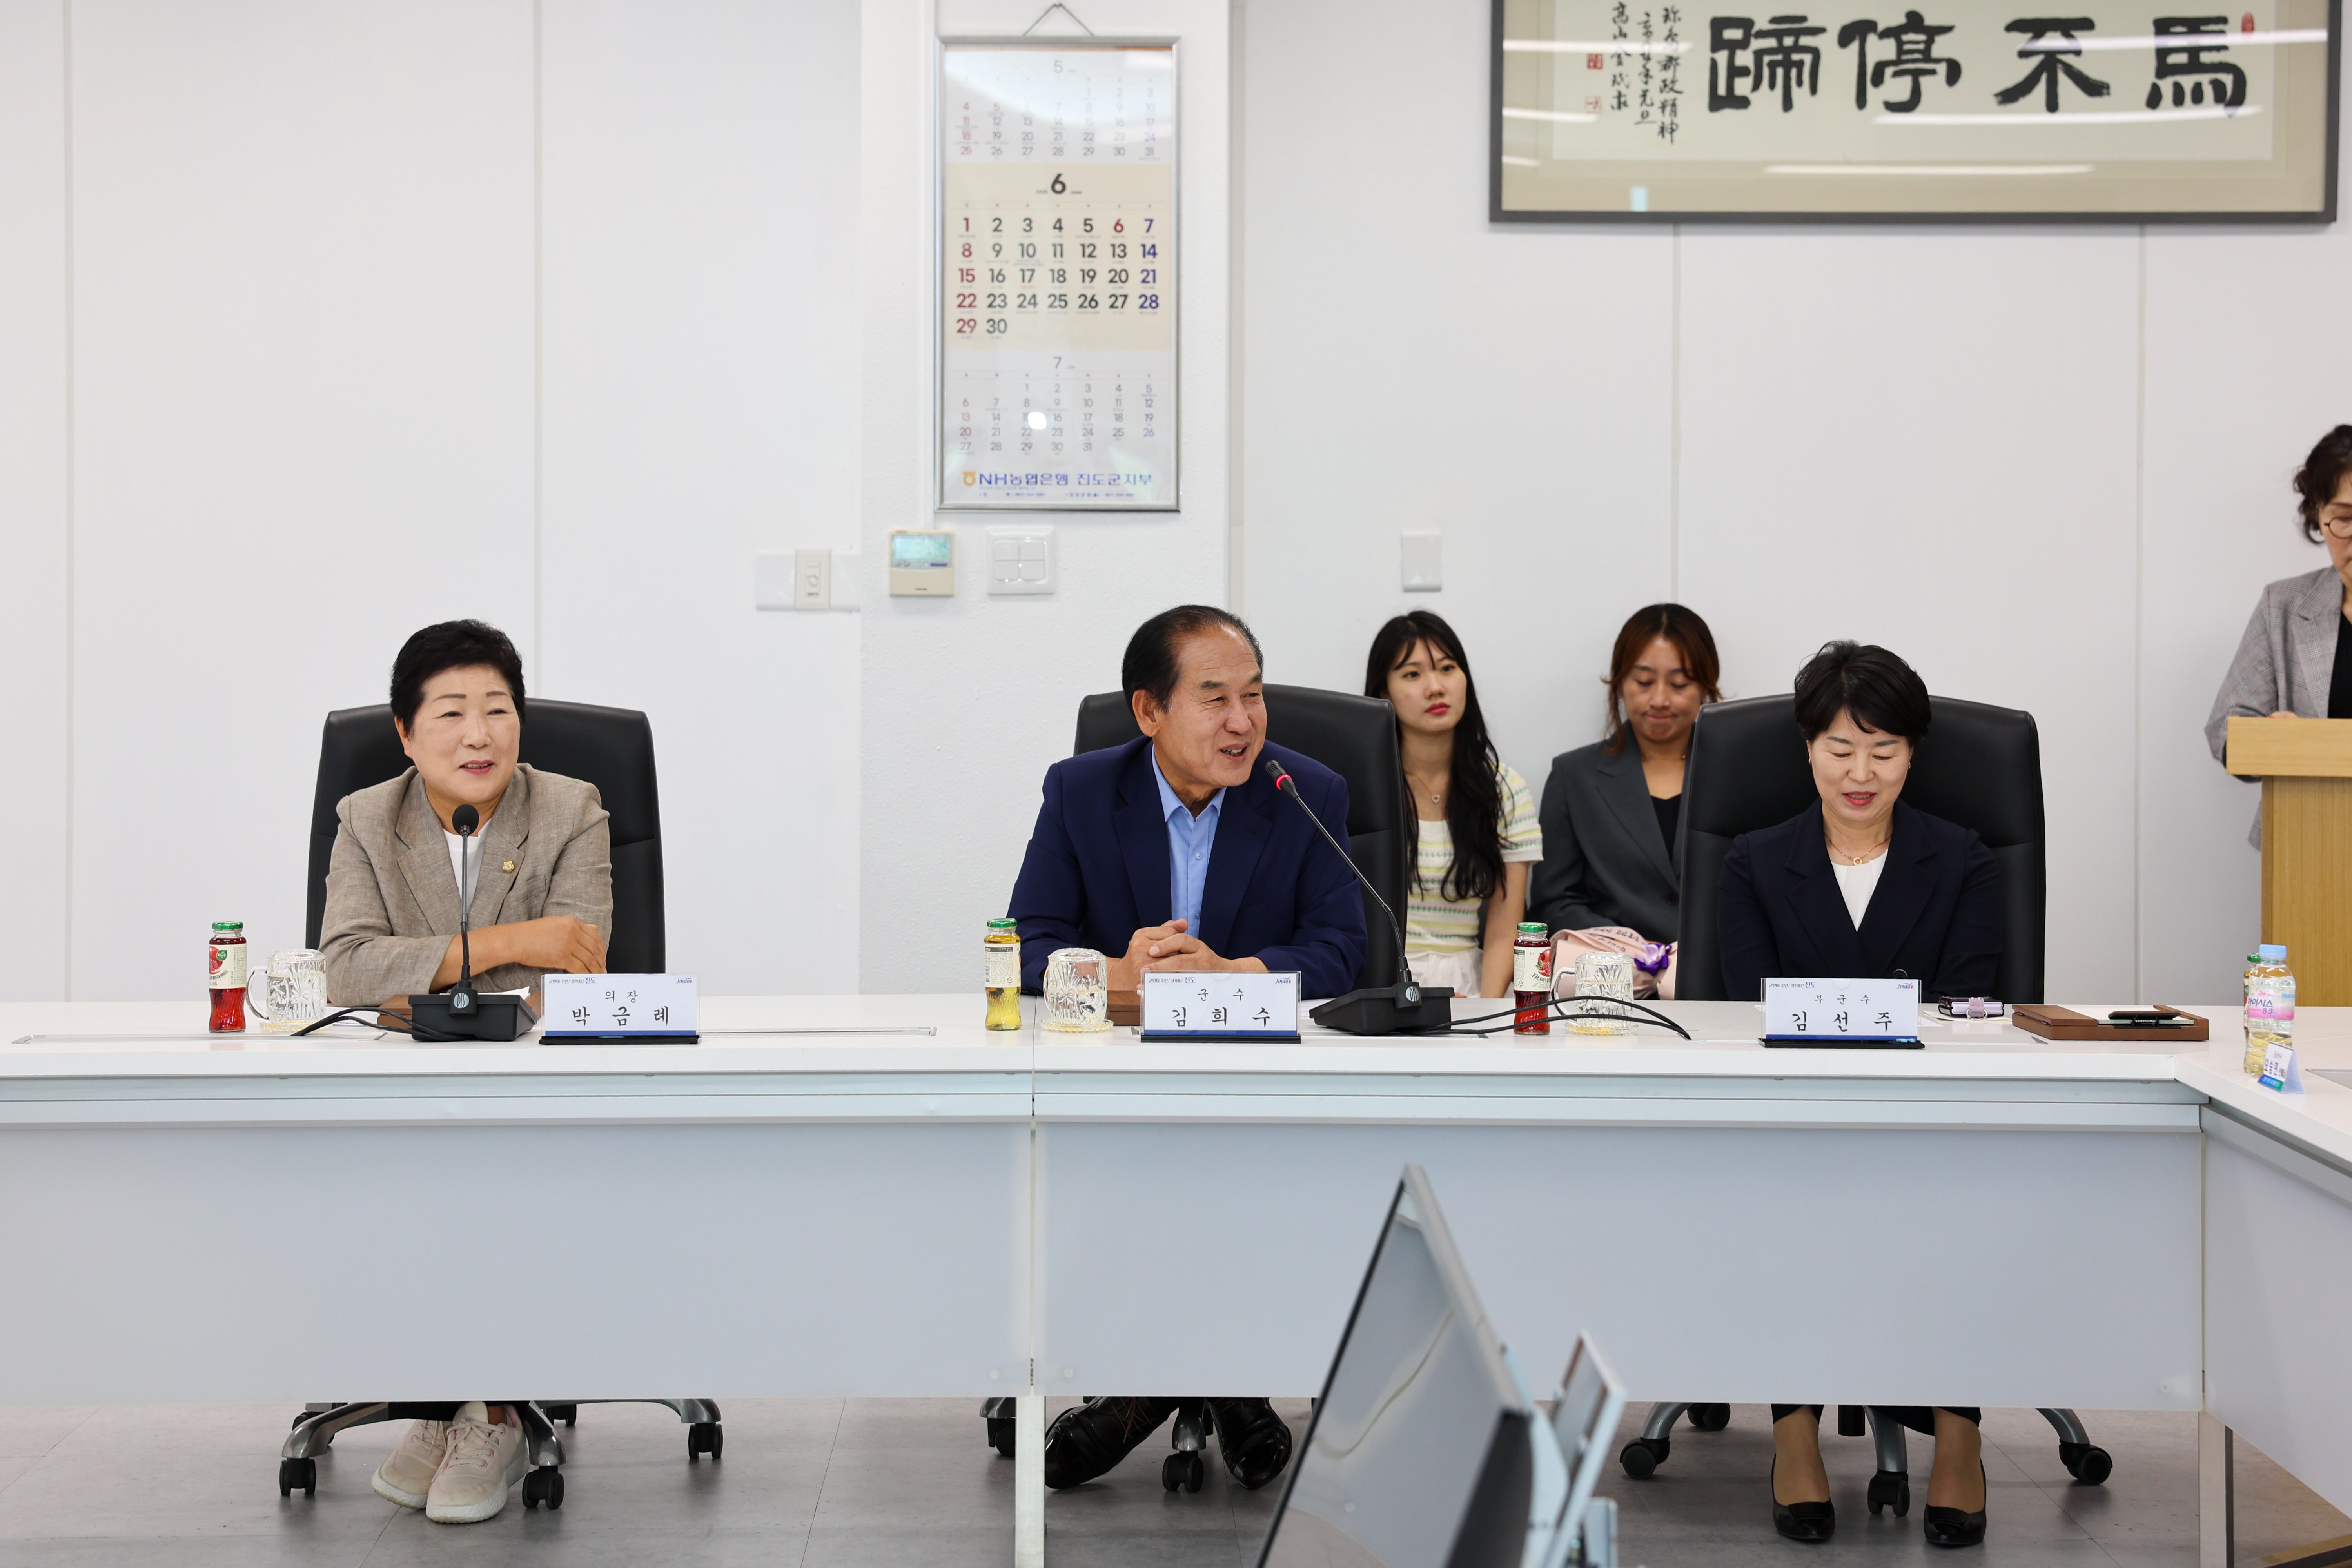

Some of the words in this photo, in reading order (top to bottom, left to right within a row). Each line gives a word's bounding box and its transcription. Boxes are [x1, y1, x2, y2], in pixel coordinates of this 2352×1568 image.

[1053, 60, 1064, 74] 5
[962, 102, 970, 111] 4
[993, 103, 1000, 111] 5
[962, 116, 970, 125] 11
[993, 116, 1002, 125] 12
[1023, 116, 1033, 125] 13
[1054, 117, 1063, 126] 14
[1115, 118, 1125, 127] 16
[1145, 117, 1155, 126] 17
[962, 131, 971, 140] 18
[993, 131, 1002, 140] 19
[1022, 132, 1034, 141] 20
[1053, 132, 1063, 142] 21
[1083, 132, 1094, 142] 22
[1144, 132, 1156, 142] 24
[961, 146, 972, 155] 25
[991, 146, 1003, 156] 26
[1022, 146, 1033, 156] 27
[1053, 146, 1064, 156] 28
[1083, 147, 1095, 156] 29
[1114, 147, 1126, 156] 30
[1145, 147, 1154, 156] 31
[1051, 173, 1066, 194] 6
[964, 217, 969, 232] 1
[992, 217, 1002, 232] 2
[1023, 217, 1033, 232] 3
[1053, 218, 1063, 232] 4
[1083, 218, 1093, 233] 5
[1113, 218, 1124, 233] 6
[1145, 218, 1154, 233] 7
[962, 243, 972, 258] 8
[992, 243, 1002, 258] 9
[1019, 243, 1036, 258] 10
[1052, 243, 1063, 258] 11
[1080, 243, 1096, 258] 12
[1110, 243, 1127, 259] 13
[1141, 244, 1157, 258] 14
[958, 268, 975, 283] 15
[989, 268, 1006, 283] 16
[1020, 269, 1035, 283] 17
[1049, 268, 1067, 283] 18
[1080, 269, 1096, 283] 19
[1108, 269, 1129, 284] 20
[1141, 269, 1156, 284] 21
[957, 293, 976, 308] 22
[987, 293, 1007, 308] 23
[1017, 293, 1038, 309] 24
[1048, 294, 1068, 309] 25
[1078, 294, 1098, 309] 26
[1109, 294, 1128, 309] 27
[1139, 294, 1159, 309] 28
[956, 318, 977, 333] 29
[986, 318, 1007, 334] 30
[1053, 356, 1062, 369] 7
[1025, 383, 1029, 392] 1
[1054, 383, 1060, 393] 2
[1085, 383, 1091, 393] 3
[1114, 383, 1122, 393] 4
[1145, 384, 1152, 393] 5
[962, 398, 969, 407] 6
[993, 397, 999, 407] 7
[1024, 398, 1030, 408] 8
[1054, 398, 1061, 407] 9
[1083, 398, 1093, 408] 10
[1115, 398, 1122, 407] 11
[1145, 398, 1154, 408] 12
[961, 412, 971, 422] 13
[992, 412, 1001, 421] 14
[1053, 413, 1062, 422] 16
[1084, 413, 1093, 422] 17
[1114, 413, 1123, 423] 18
[1145, 413, 1154, 422] 19
[960, 427, 972, 436] 20
[991, 427, 1001, 437] 21
[1021, 427, 1033, 437] 22
[1052, 427, 1063, 437] 23
[1082, 428, 1093, 437] 24
[1113, 427, 1124, 437] 25
[1143, 428, 1155, 437] 26
[961, 441, 971, 450] 27
[991, 441, 1002, 451] 28
[1021, 442, 1033, 451] 29
[1051, 442, 1063, 452] 30
[1083, 442, 1092, 452] 31
[980, 473, 1069, 486] NH농협은행
[1077, 473, 1152, 486] 진도군지부
[605, 990, 615, 1002] 의
[626, 990, 639, 1003] 장
[1197, 988, 1209, 1001] 군
[1232, 988, 1244, 1001] 수
[1814, 995, 1823, 1004] 부
[1837, 995, 1846, 1005] 군
[1860, 995, 1869, 1005] 수
[572, 1006, 590, 1027] 박
[612, 1006, 630, 1026] 금
[654, 1006, 669, 1026] 례
[1171, 1007, 1186, 1027] 김
[1211, 1007, 1227, 1027] 희
[1252, 1007, 1270, 1027] 수
[1791, 1011, 1807, 1032] 김
[1832, 1011, 1848, 1032] 선
[1873, 1012, 1892, 1032] 주
